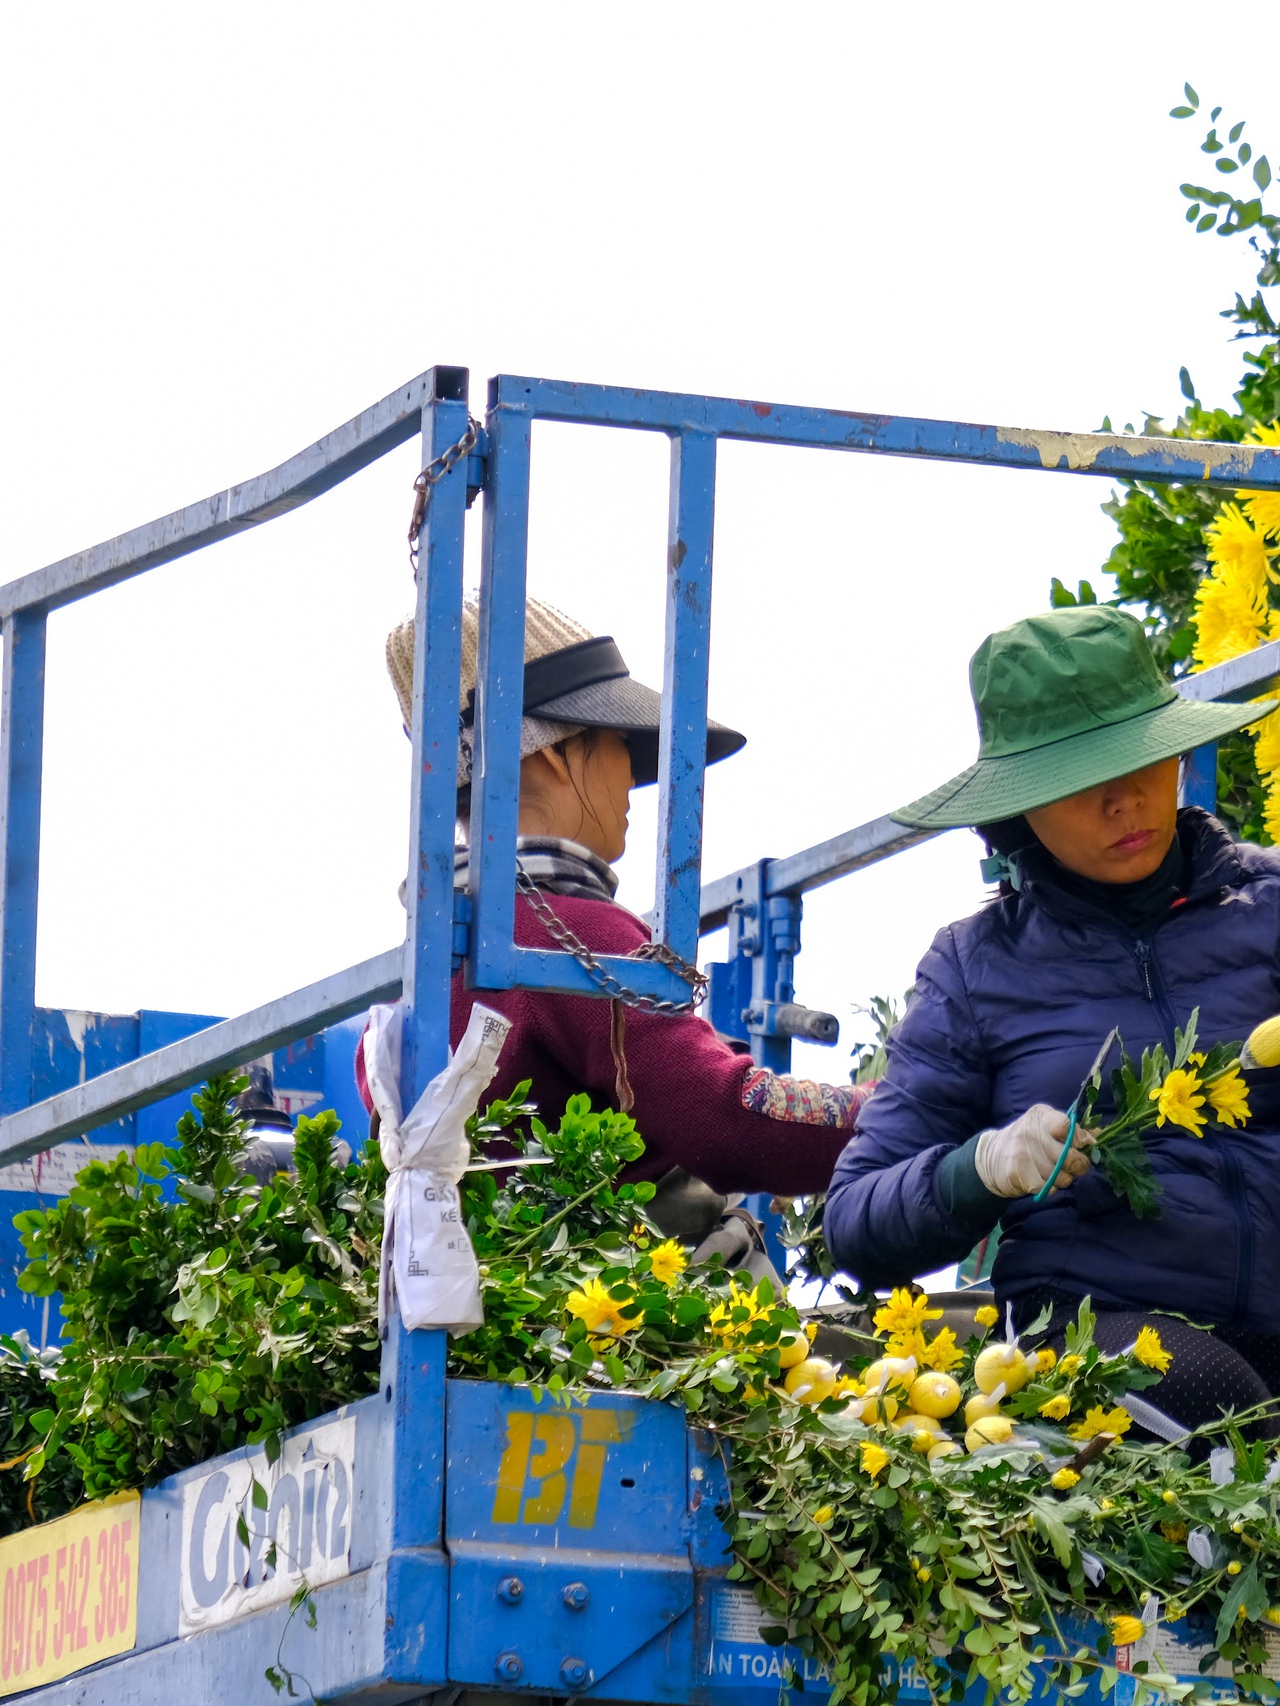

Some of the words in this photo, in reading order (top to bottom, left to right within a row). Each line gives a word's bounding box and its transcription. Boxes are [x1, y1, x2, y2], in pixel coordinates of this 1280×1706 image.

[491, 1408, 634, 1529] BT
[2, 1554, 49, 1681] 0975
[53, 1536, 90, 1660] 542
[94, 1519, 132, 1643] 385
